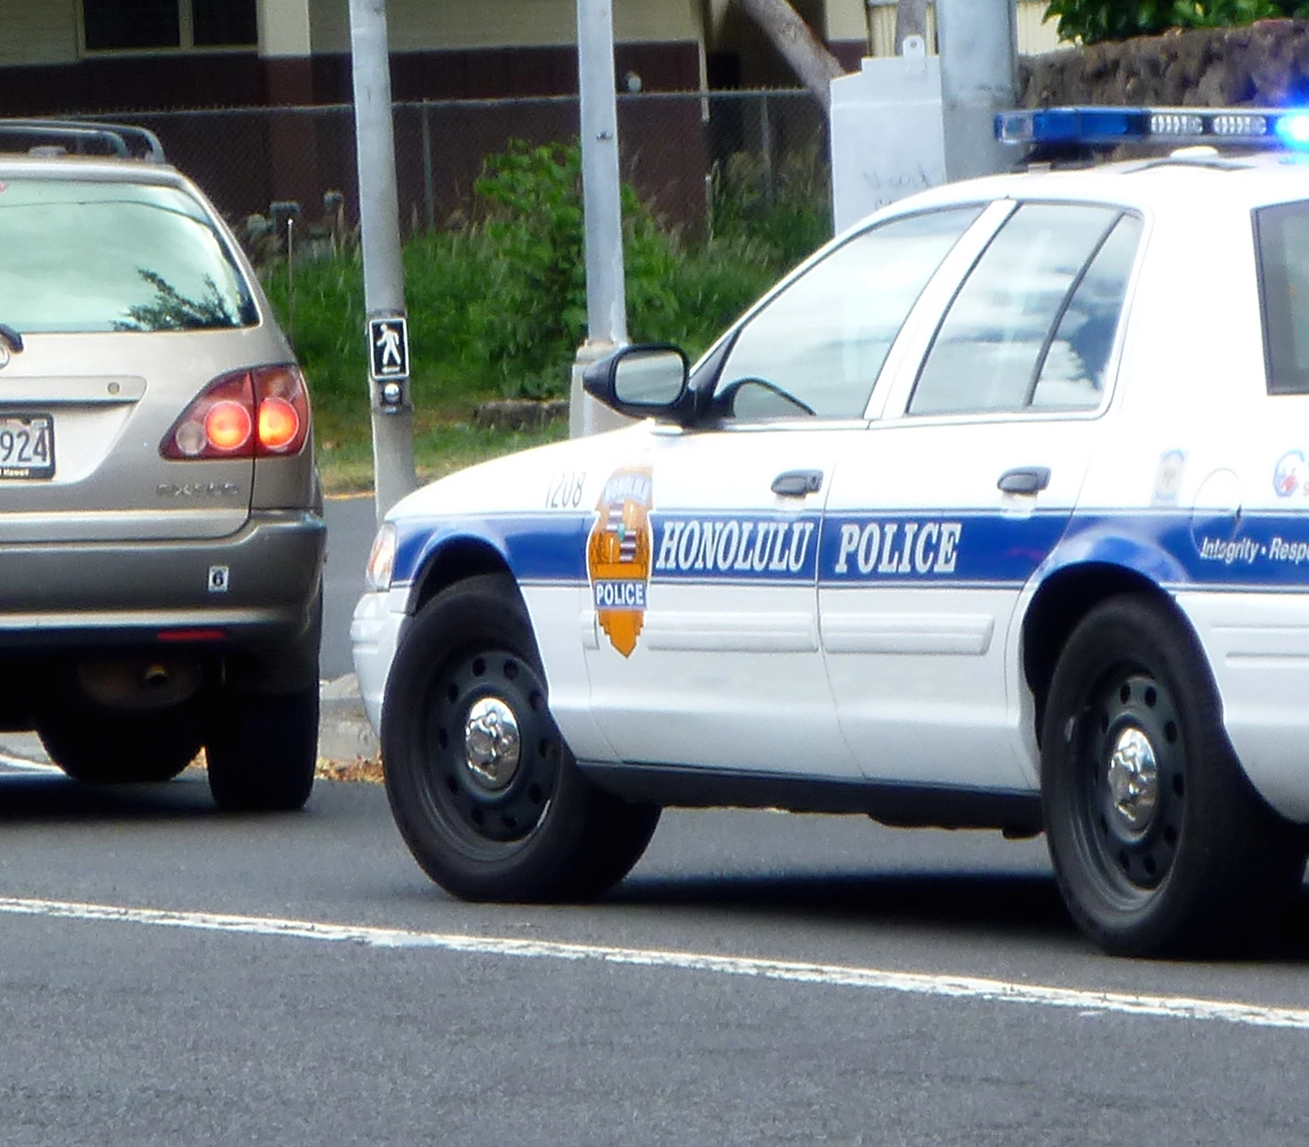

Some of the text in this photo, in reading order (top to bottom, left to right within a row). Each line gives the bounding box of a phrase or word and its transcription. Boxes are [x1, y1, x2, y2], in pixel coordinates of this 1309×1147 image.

[0, 426, 47, 463] 924
[655, 519, 963, 574] HONOLULU POLICE
[1200, 537, 1259, 564] Integrity
[596, 583, 644, 605] POLICE
